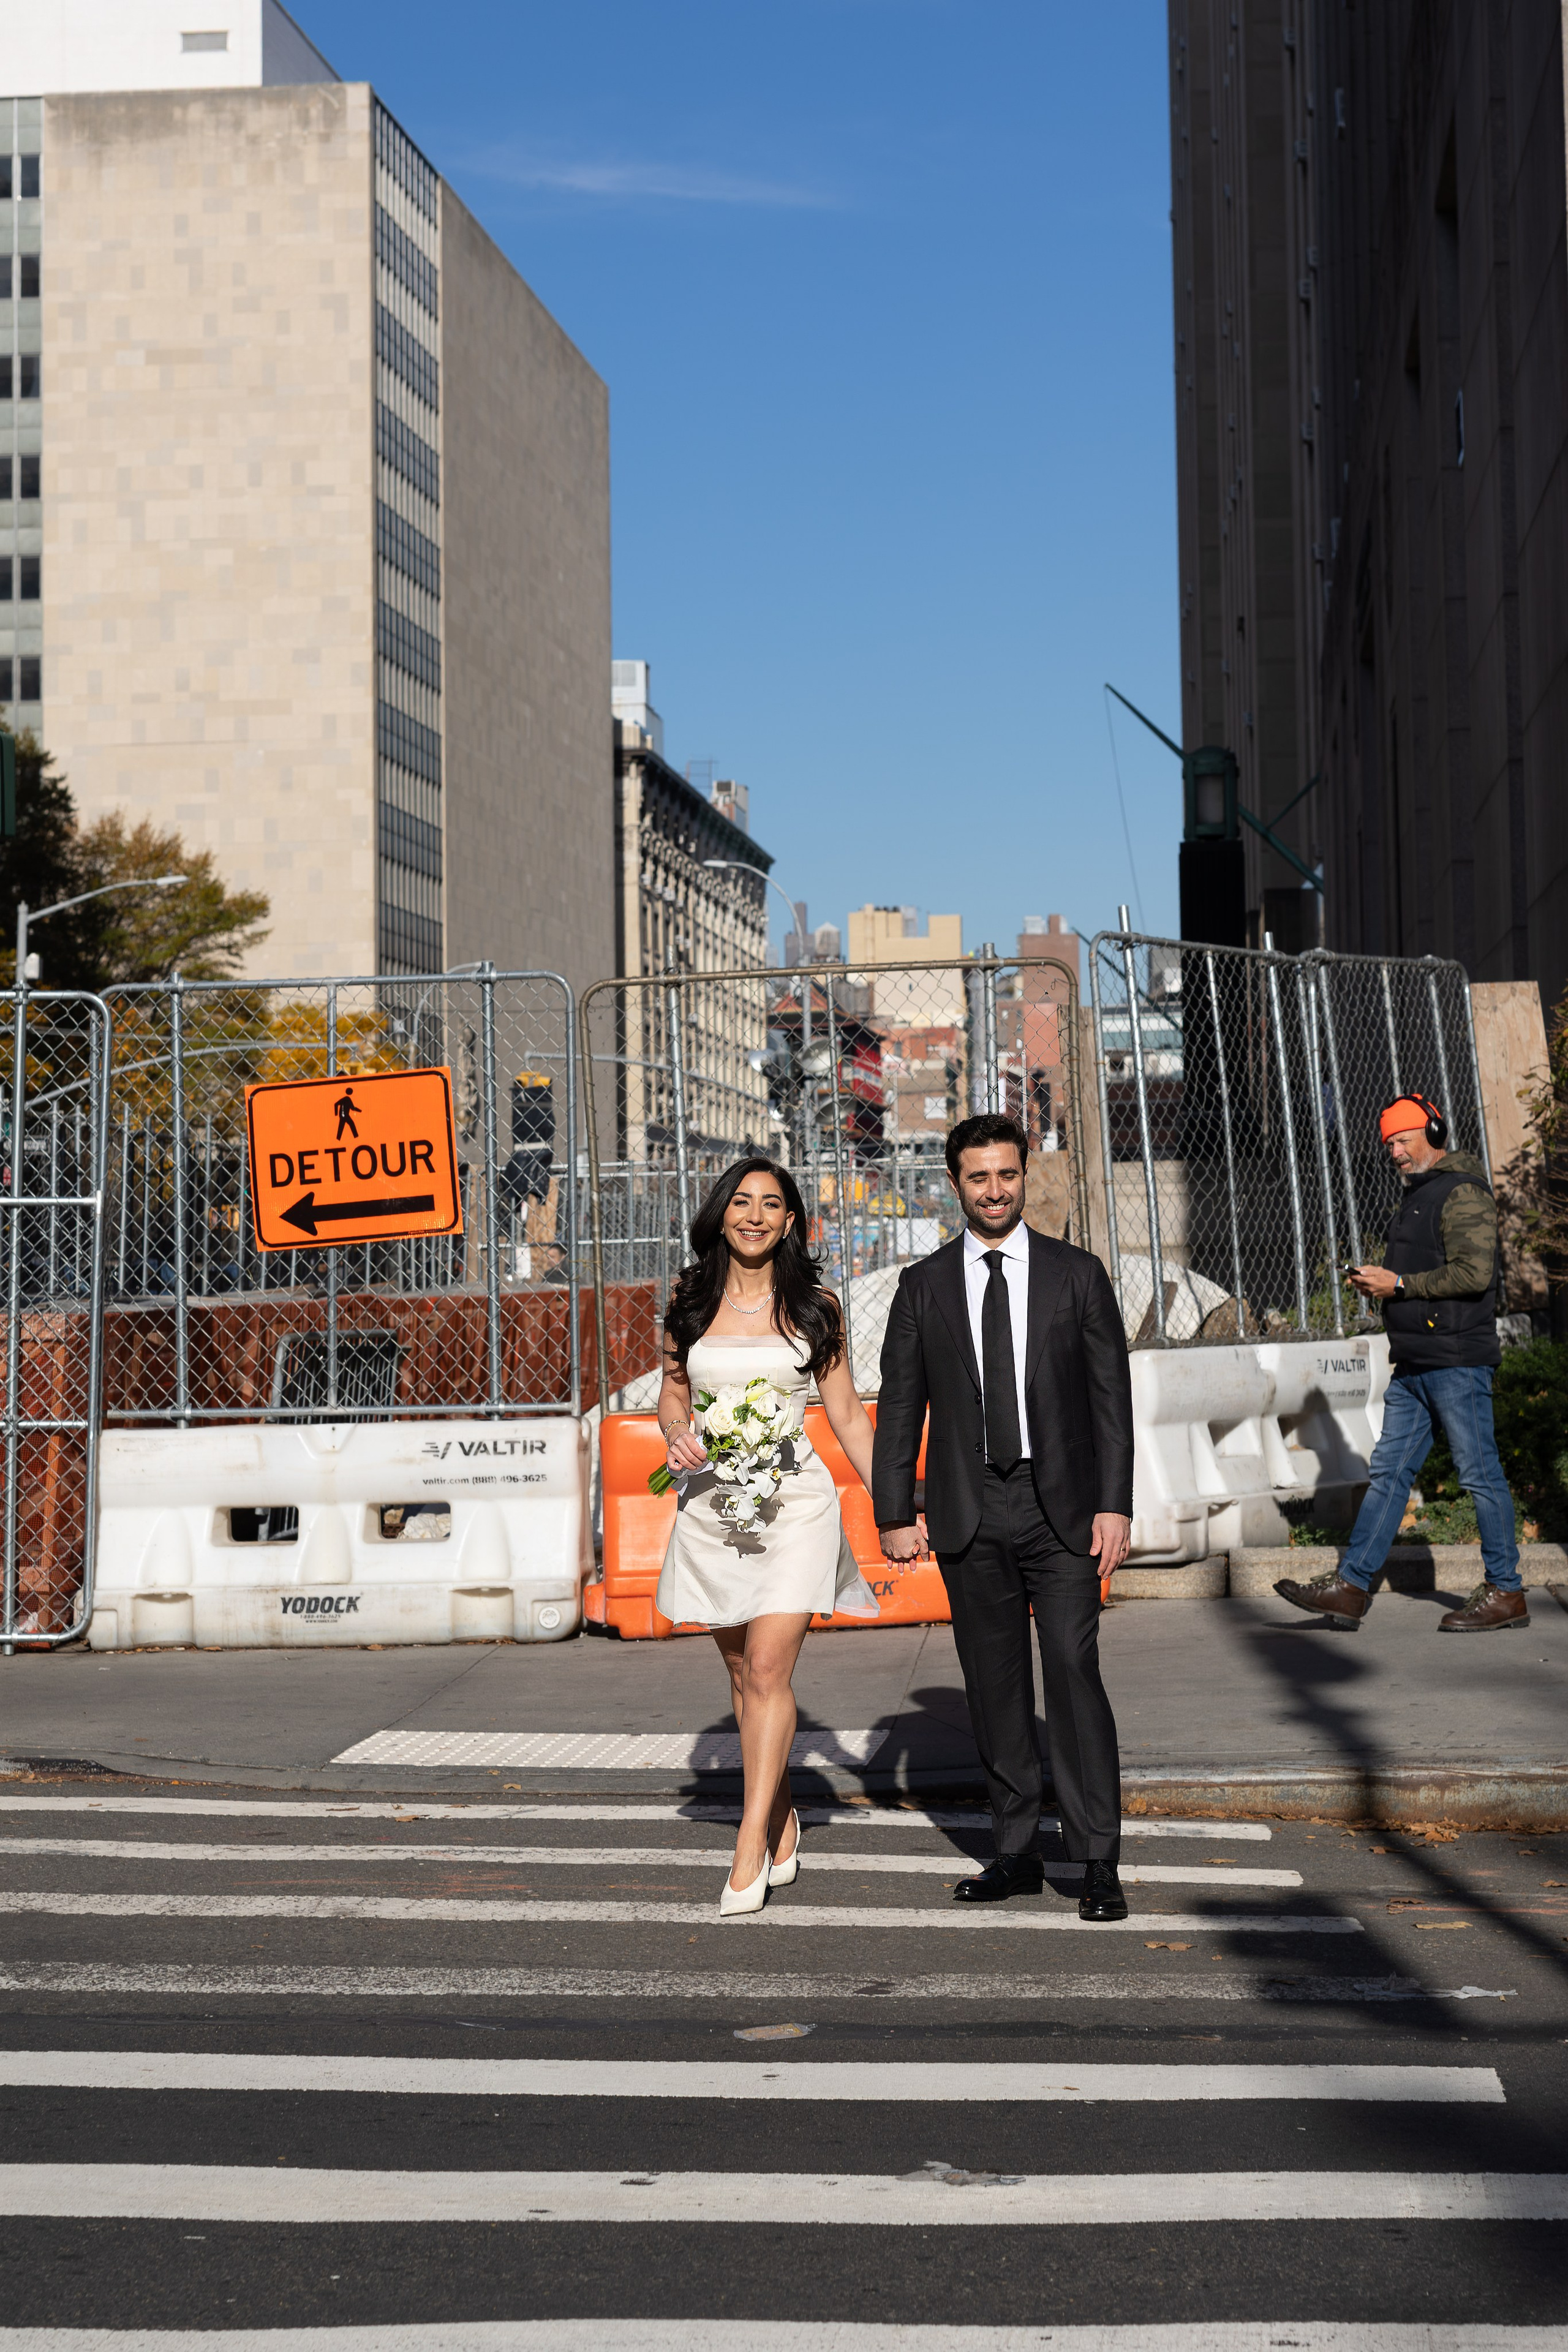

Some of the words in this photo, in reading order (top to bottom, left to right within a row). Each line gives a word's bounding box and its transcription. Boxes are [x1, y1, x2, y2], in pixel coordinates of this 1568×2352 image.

[269, 1139, 436, 1188] DETOUR
[1330, 1359, 1366, 1373] VALTIR
[458, 1439, 547, 1457] VALTIR
[422, 1476, 470, 1485] valtir.com
[500, 1474, 548, 1483] 496-3625
[280, 1596, 361, 1614] YODOCK
